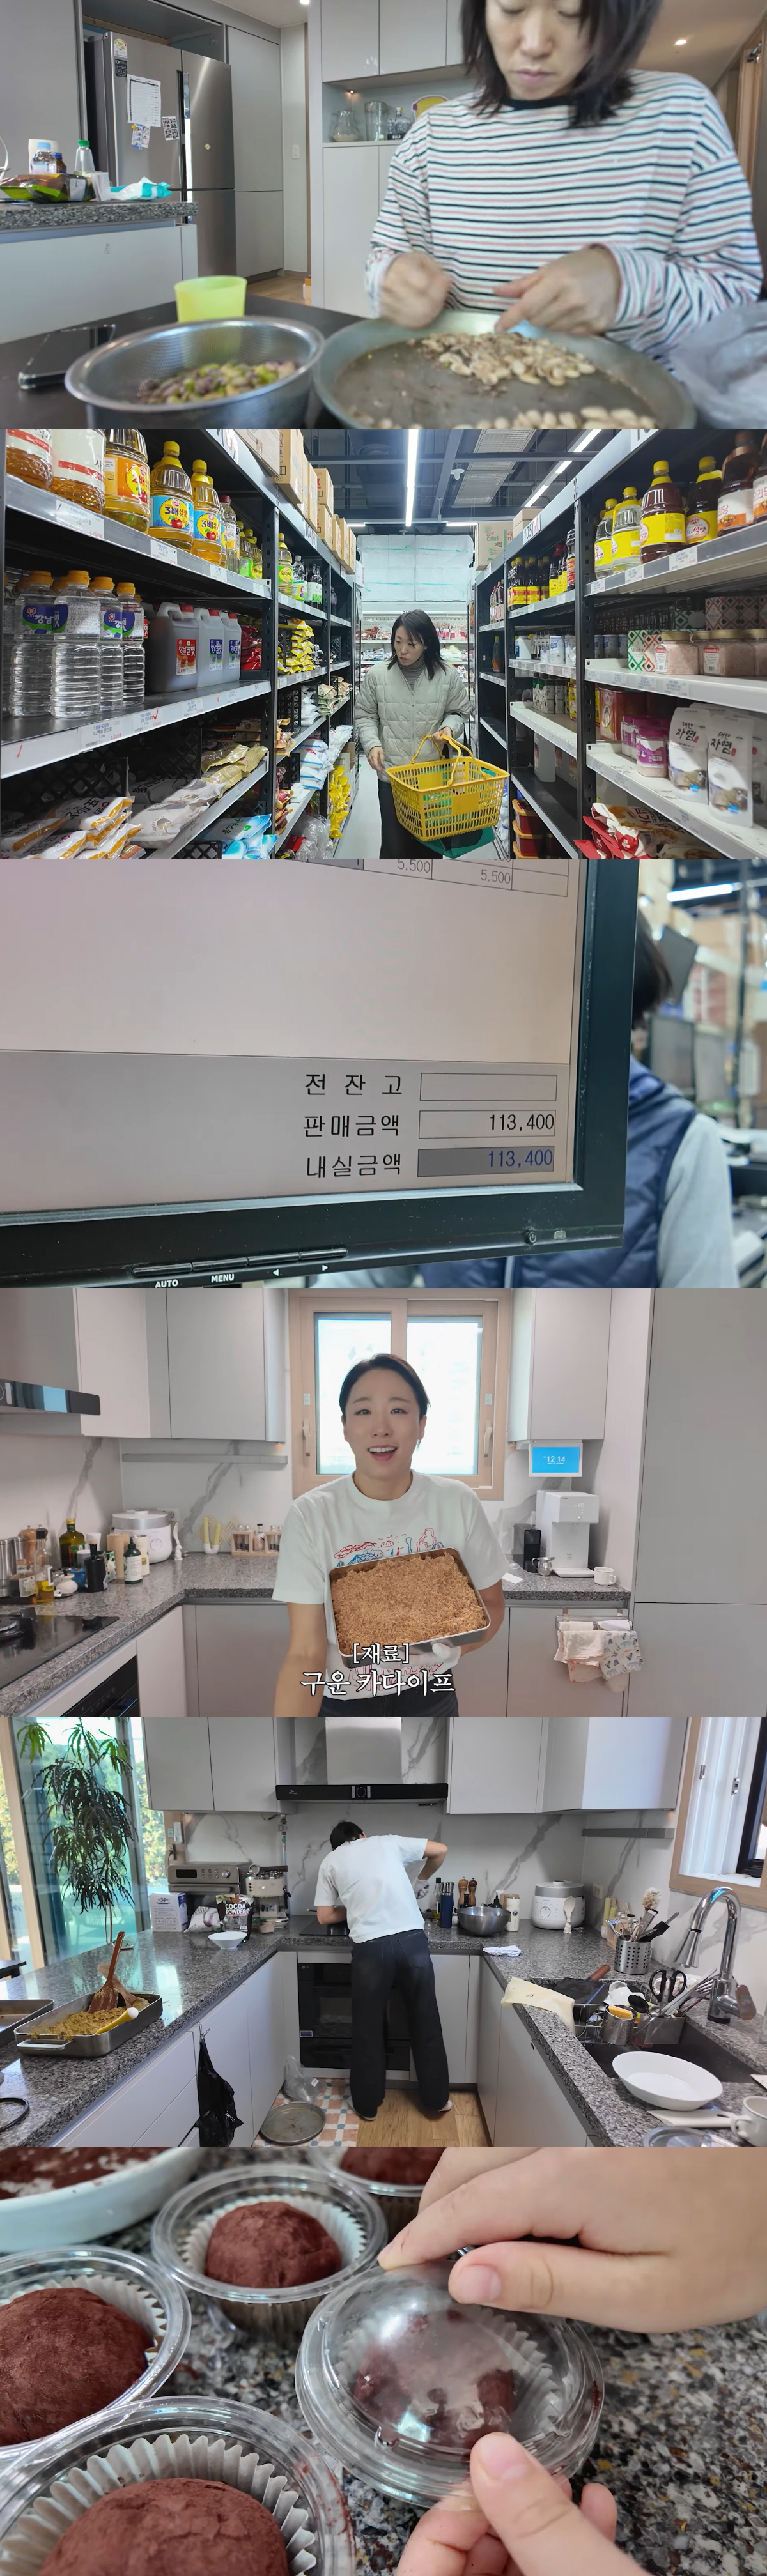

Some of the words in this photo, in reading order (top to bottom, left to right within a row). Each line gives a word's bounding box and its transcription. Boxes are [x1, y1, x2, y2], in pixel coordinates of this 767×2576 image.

[164, 506, 178, 516] 3배
[305, 1073, 326, 1096] 전
[344, 1073, 366, 1096] 잔
[382, 1075, 403, 1095] 고
[303, 1114, 399, 1138] 판매금액
[489, 1114, 555, 1132] 113,400
[307, 1153, 401, 1179] 내실금액
[488, 1149, 553, 1169] 113,400
[155, 1279, 179, 1288] AUTO
[210, 1273, 235, 1283] MENU
